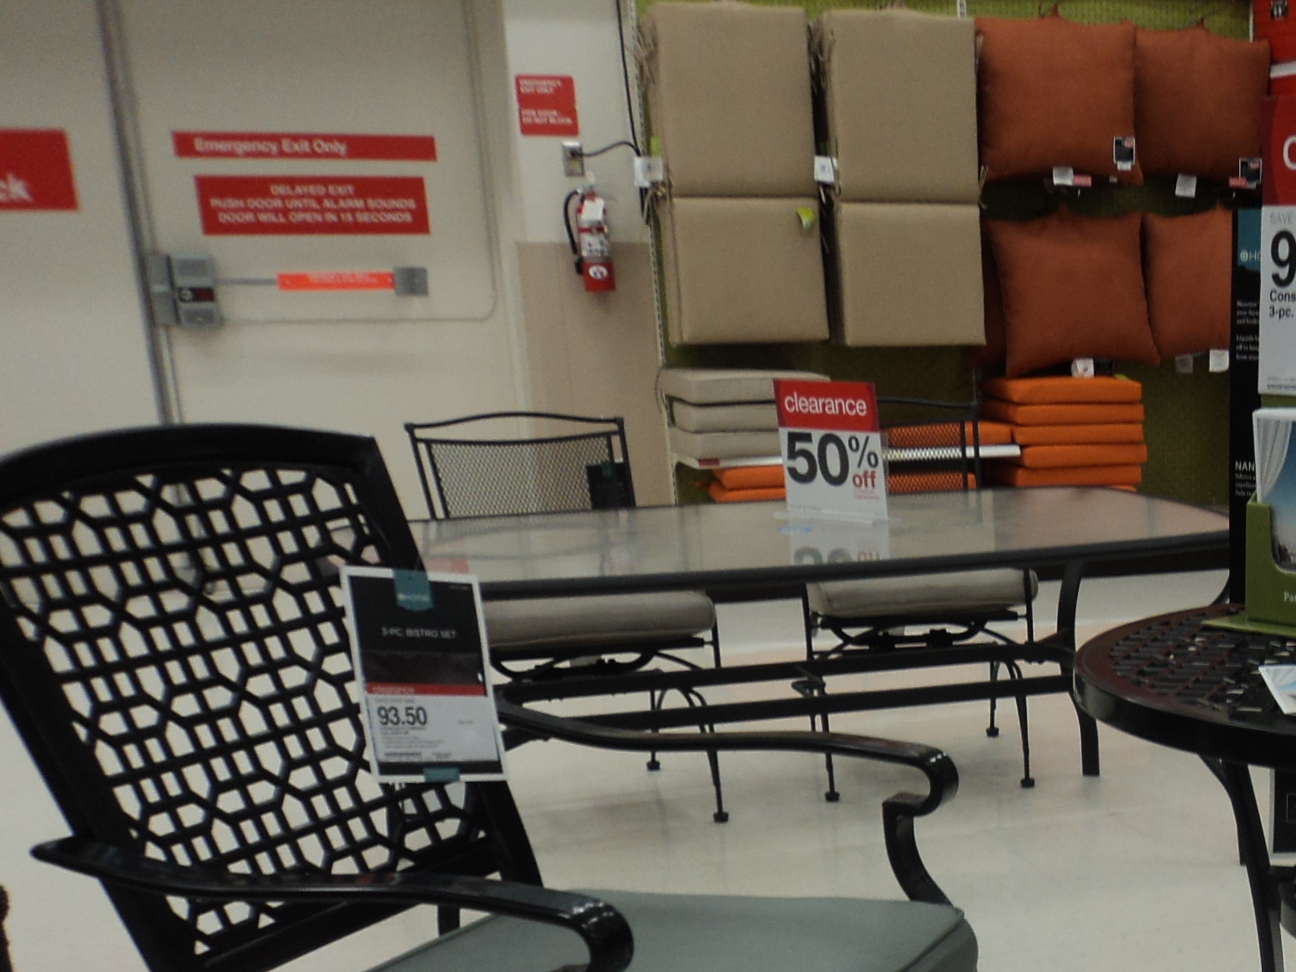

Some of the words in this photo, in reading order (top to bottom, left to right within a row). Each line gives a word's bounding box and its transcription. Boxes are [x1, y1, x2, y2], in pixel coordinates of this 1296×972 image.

[194, 137, 278, 155] Emergency
[281, 139, 311, 152] Exit
[313, 140, 348, 156] Only
[270, 184, 326, 196] DELAYED
[328, 184, 355, 196] EXIT
[209, 198, 246, 209] PUSH
[247, 198, 283, 209] DOOR
[367, 198, 416, 209] SOUNDS
[218, 211, 254, 223] DOOR
[355, 211, 413, 223] SECONDS
[1269, 212, 1292, 225] SAVE
[1268, 305, 1294, 320] 3-pc.
[784, 392, 867, 416] clearance
[852, 470, 877, 488] off
[405, 628, 438, 638] BISTRO
[440, 630, 457, 639] SET
[377, 705, 428, 726] 93.50
